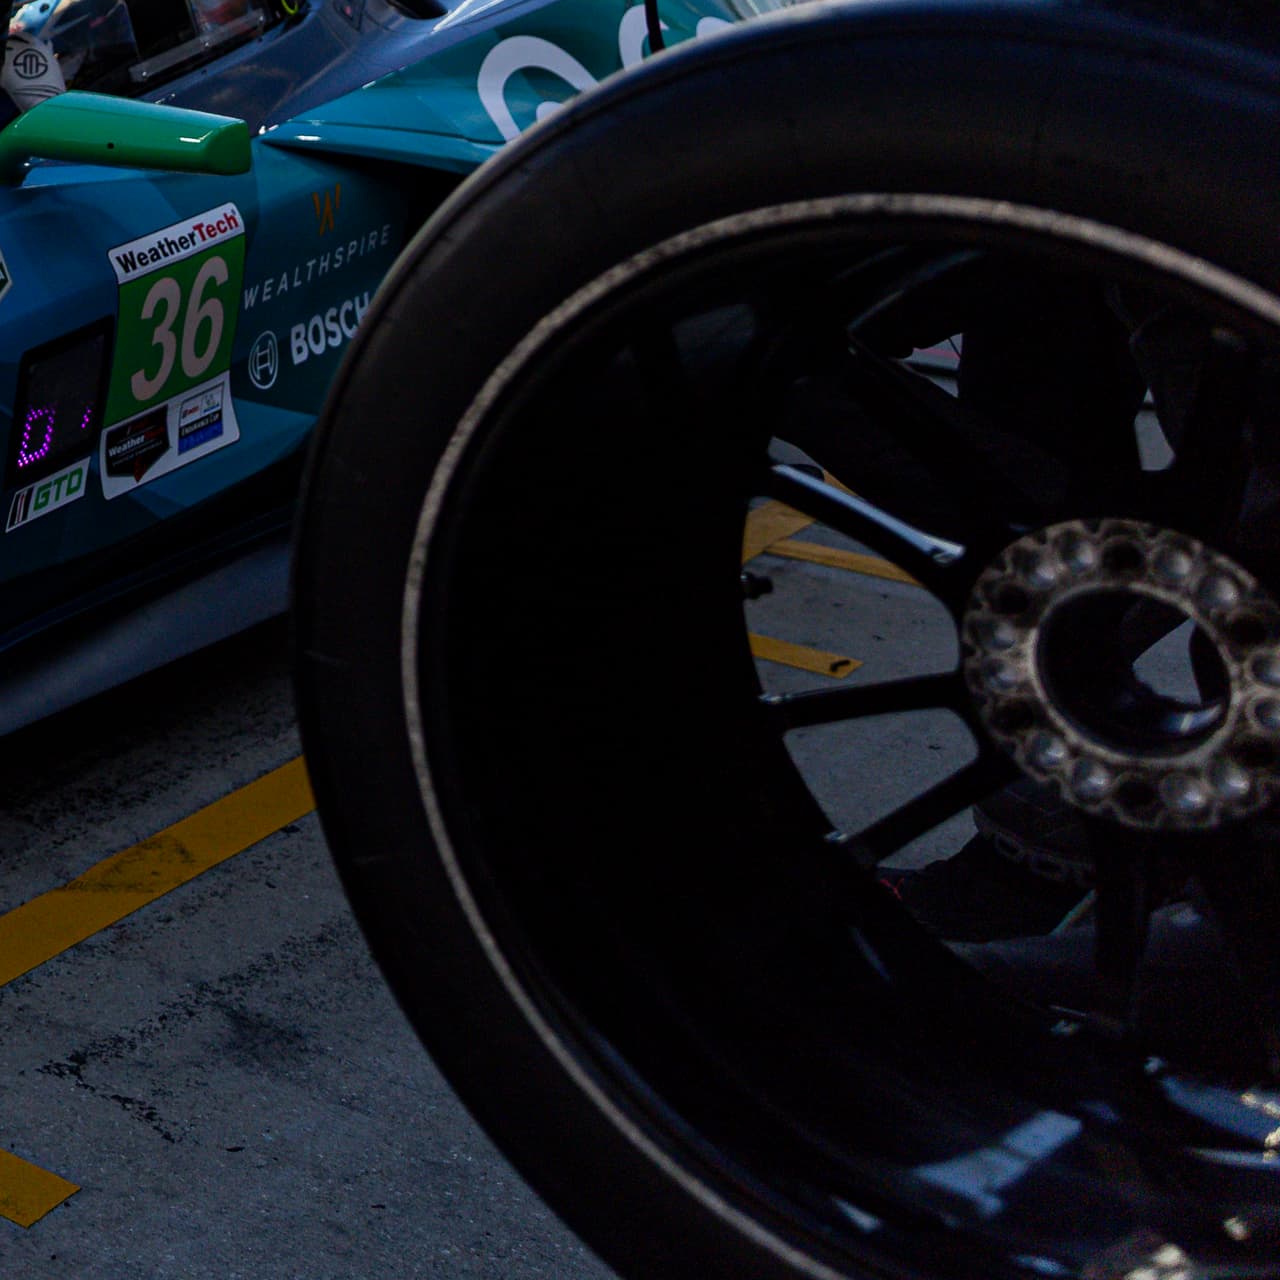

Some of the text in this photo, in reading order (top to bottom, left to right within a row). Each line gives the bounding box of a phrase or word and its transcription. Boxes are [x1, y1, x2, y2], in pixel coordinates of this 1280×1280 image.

[117, 212, 240, 275] WeatherTech
[243, 223, 392, 311] WEALTHSPIRE
[131, 255, 230, 402] 36
[33, 468, 83, 510] GTD
